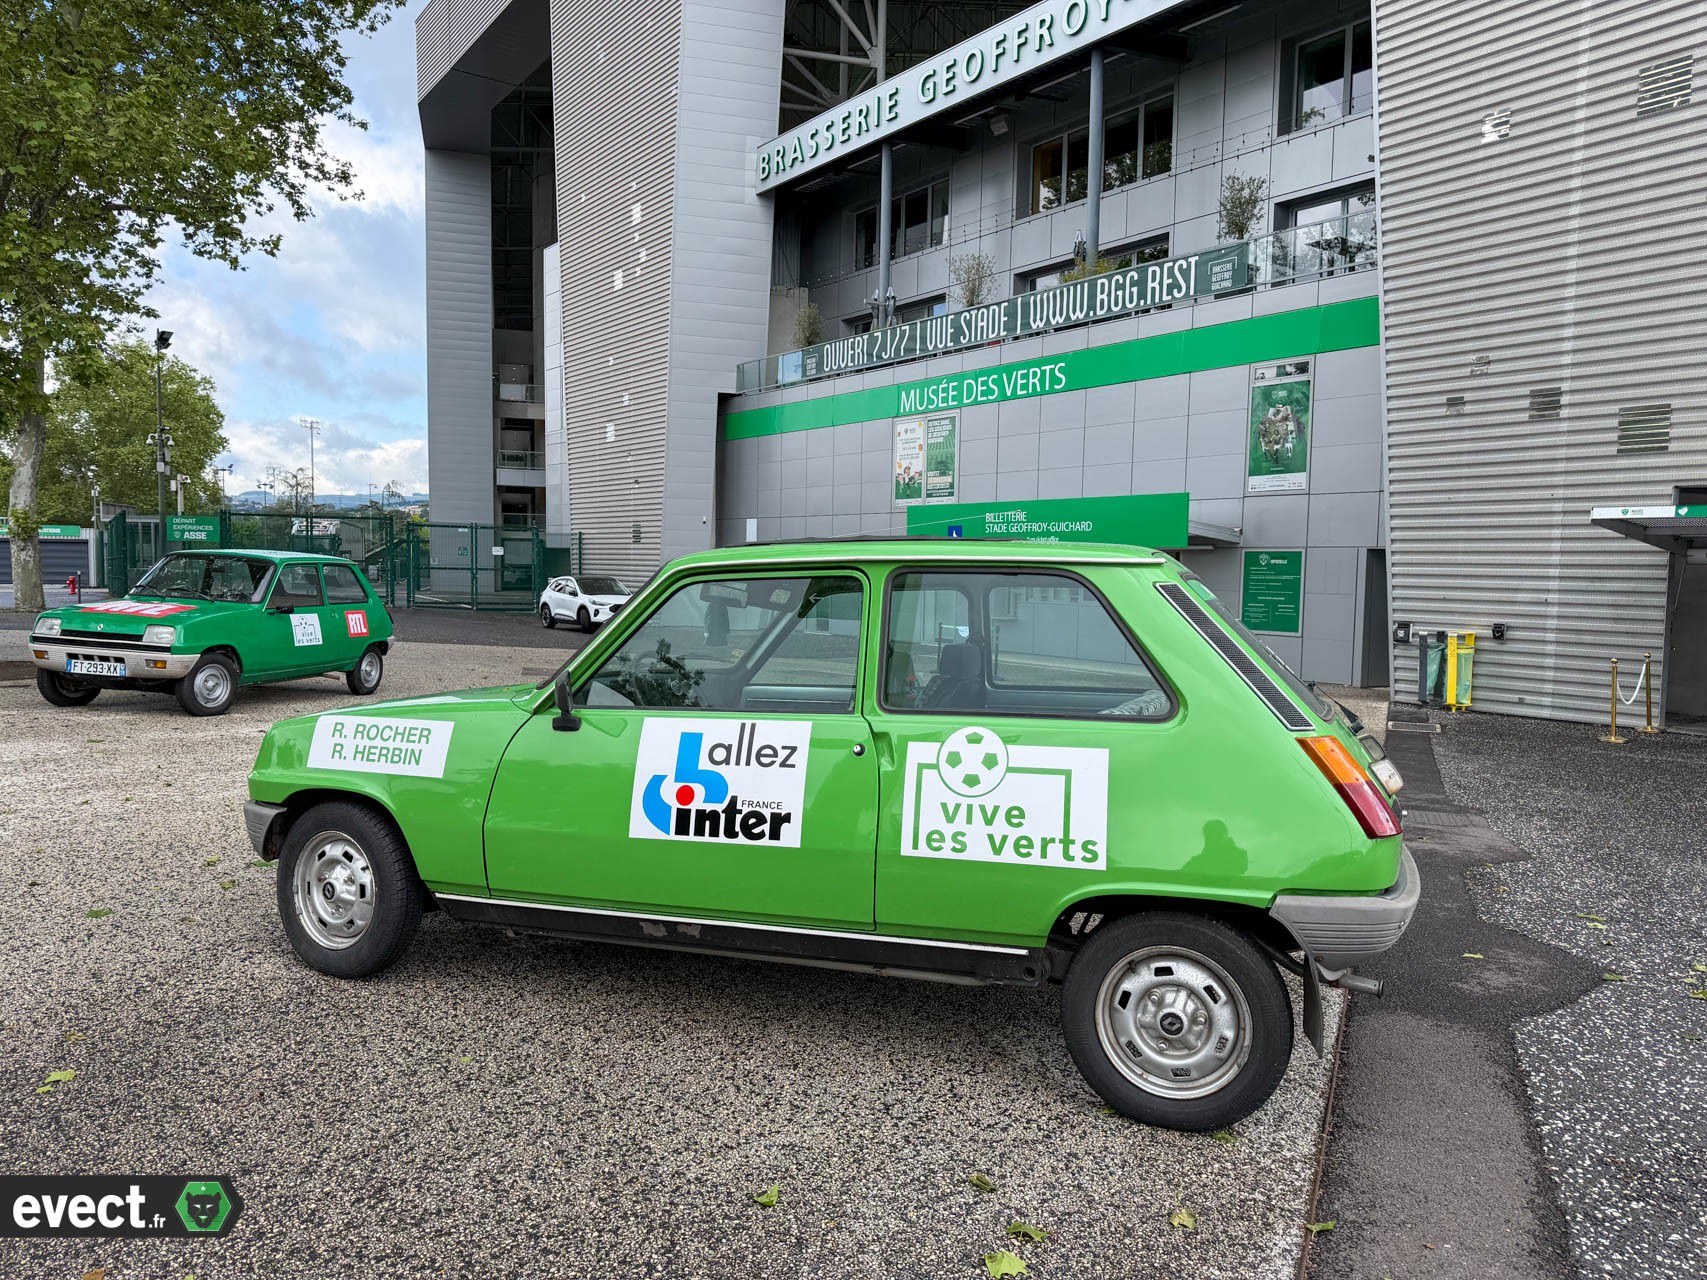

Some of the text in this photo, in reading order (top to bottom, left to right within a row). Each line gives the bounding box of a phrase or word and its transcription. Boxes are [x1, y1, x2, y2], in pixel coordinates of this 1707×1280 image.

[759, 87, 899, 181] BRASSERIE
[823, 334, 869, 371] OUVERT
[927, 315, 955, 351] VUE
[960, 300, 1009, 344] STADE
[1029, 256, 1199, 330] WWW.BGG.REST
[900, 362, 1066, 413] MUSÉE DES VERTS
[985, 511, 1027, 523] BILLETTERIE
[985, 521, 1093, 533] STADE GEOFFROY-GUICHARD
[183, 531, 207, 540] ASSE
[347, 613, 367, 634] RTL
[73, 661, 118, 675] FT-293-XX
[331, 721, 432, 745] R. ROCHER
[331, 742, 423, 766] R. HERBIN
[708, 722, 798, 769] allez
[674, 785, 792, 841] inter
[741, 799, 783, 810] FRANCE
[940, 801, 1026, 829] vive
[986, 833, 1099, 863] verts
